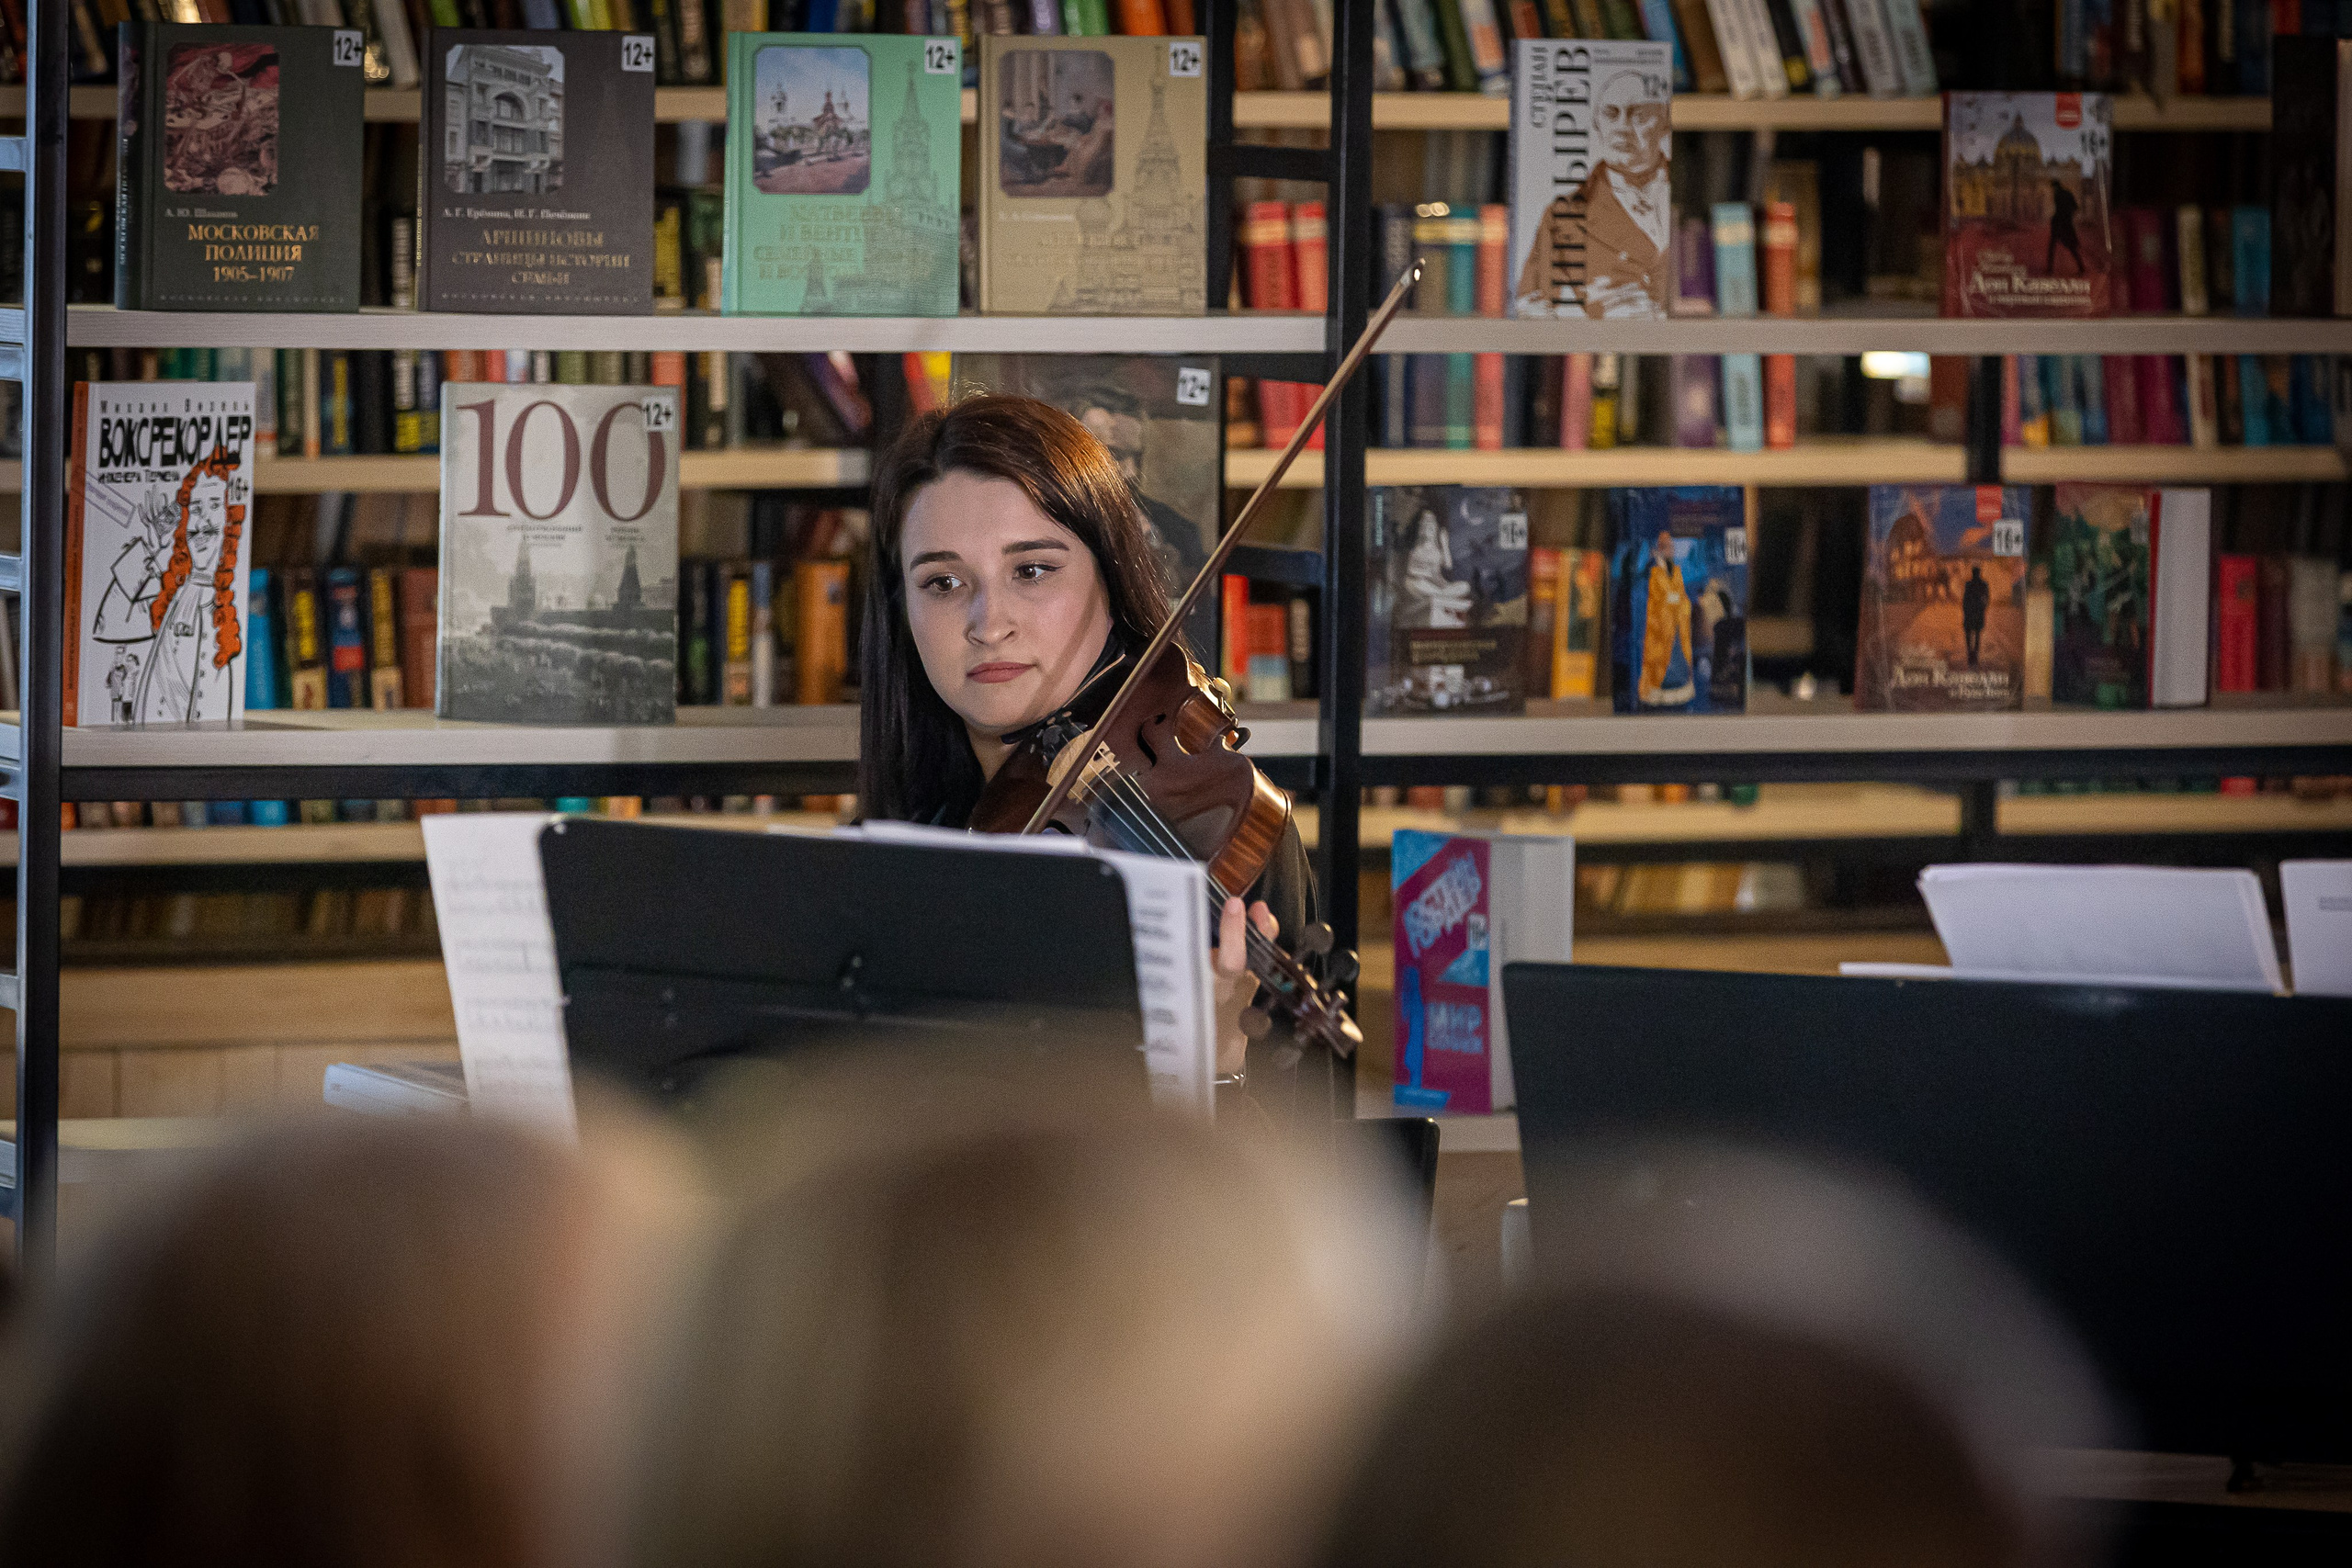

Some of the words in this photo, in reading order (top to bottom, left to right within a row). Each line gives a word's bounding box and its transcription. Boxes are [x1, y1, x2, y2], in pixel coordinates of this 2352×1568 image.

[336, 37, 363, 61] 12+
[624, 43, 653, 66] 12+
[925, 46, 955, 69] 12+
[1172, 48, 1199, 71] 12+
[187, 224, 320, 242] МОСКОВСКАЯ
[204, 244, 302, 262] ПОЛИЦИЯ
[1180, 376, 1207, 397] 12+
[645, 401, 672, 425] 12+
[98, 416, 251, 468] ВОКСРЕКОРДЕР
[457, 399, 666, 522] 100
[229, 477, 249, 501] 16+
